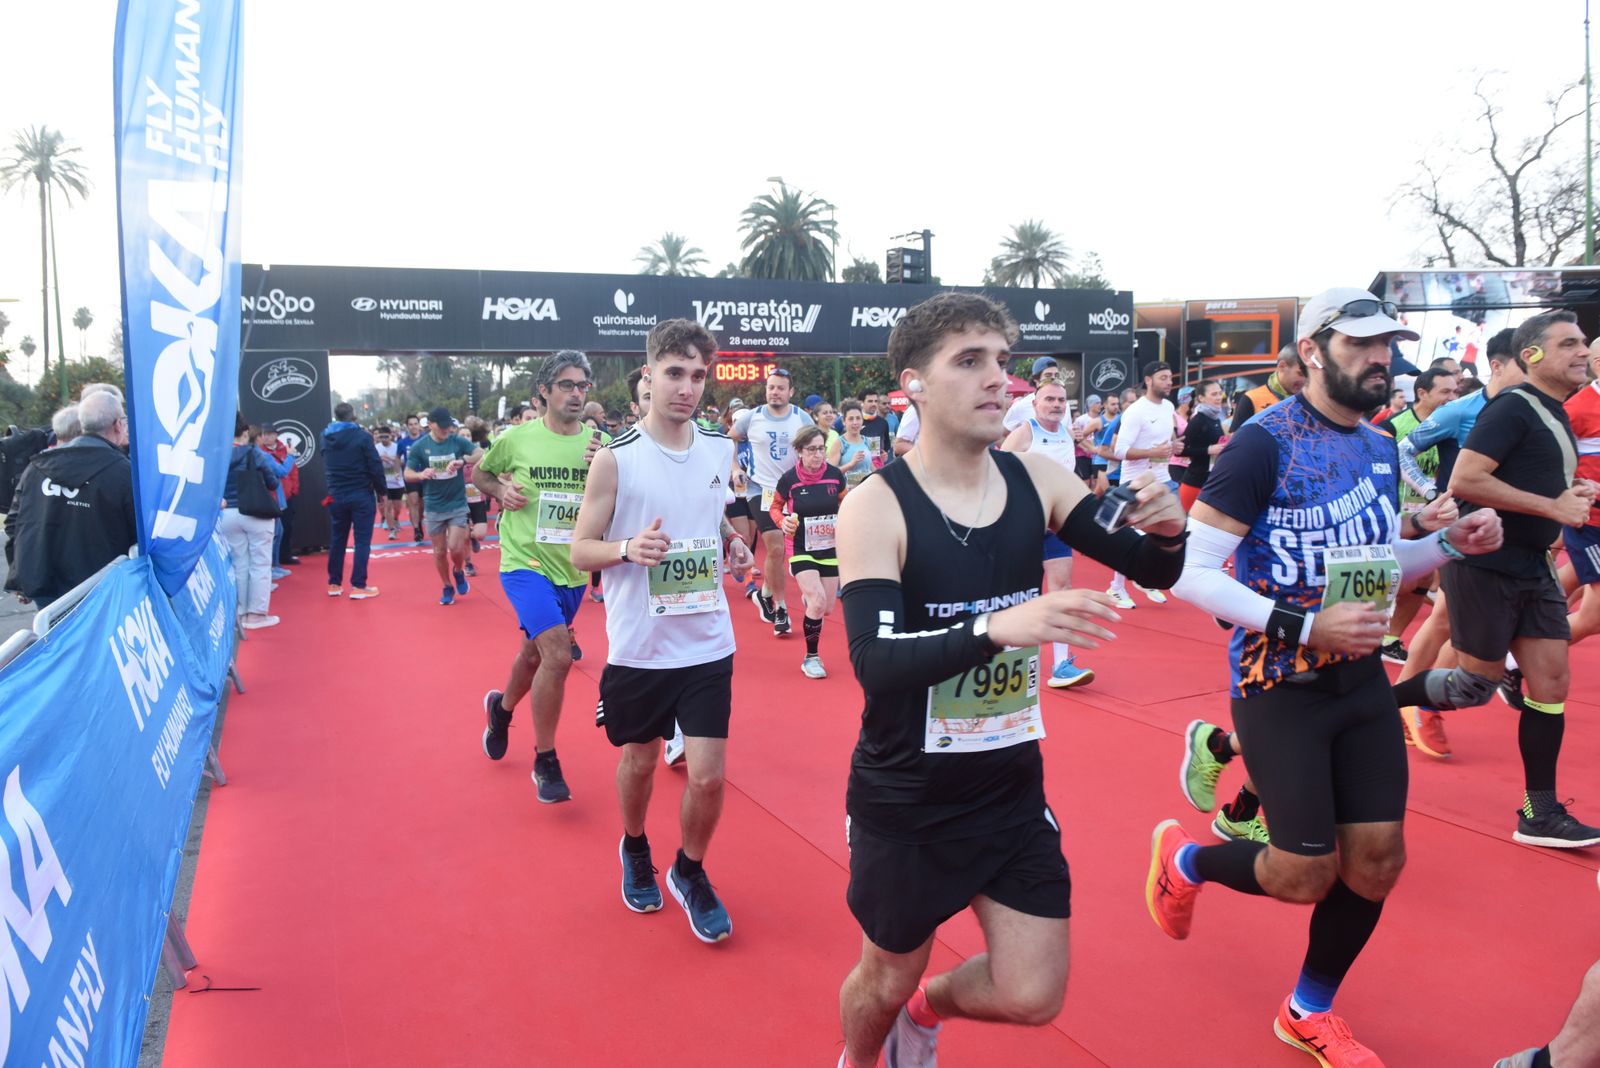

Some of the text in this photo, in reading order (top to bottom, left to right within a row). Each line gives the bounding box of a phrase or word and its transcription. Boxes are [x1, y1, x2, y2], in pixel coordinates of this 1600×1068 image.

[174, 0, 202, 165] HUMAN
[145, 74, 174, 157] FLY
[202, 90, 229, 174] FLY
[379, 298, 443, 311] HYUNDAI
[379, 312, 443, 321] Hyundauto Motor
[482, 296, 559, 321] HOKA
[716, 299, 803, 318] maratón
[242, 318, 284, 326] ANTAMIENTO
[598, 329, 630, 337] Healthcare
[739, 313, 802, 333] sevilla
[729, 336, 790, 347] 28 enero 2024
[147, 179, 229, 543] HOKA
[529, 466, 588, 482] MUSHO BE
[1371, 462, 1393, 475] HOKA
[535, 481, 562, 489] OVIEDO
[1266, 475, 1379, 530] MEDIO MARATÓN
[692, 538, 712, 550] SEVILLA
[659, 556, 709, 582] 7994
[1340, 567, 1387, 599] 7664
[924, 587, 1040, 618] TOP4RUNNING
[108, 595, 175, 733] HOKA
[954, 658, 1024, 699] 7995
[151, 744, 172, 790] FLY
[68, 931, 106, 1034] FLY
